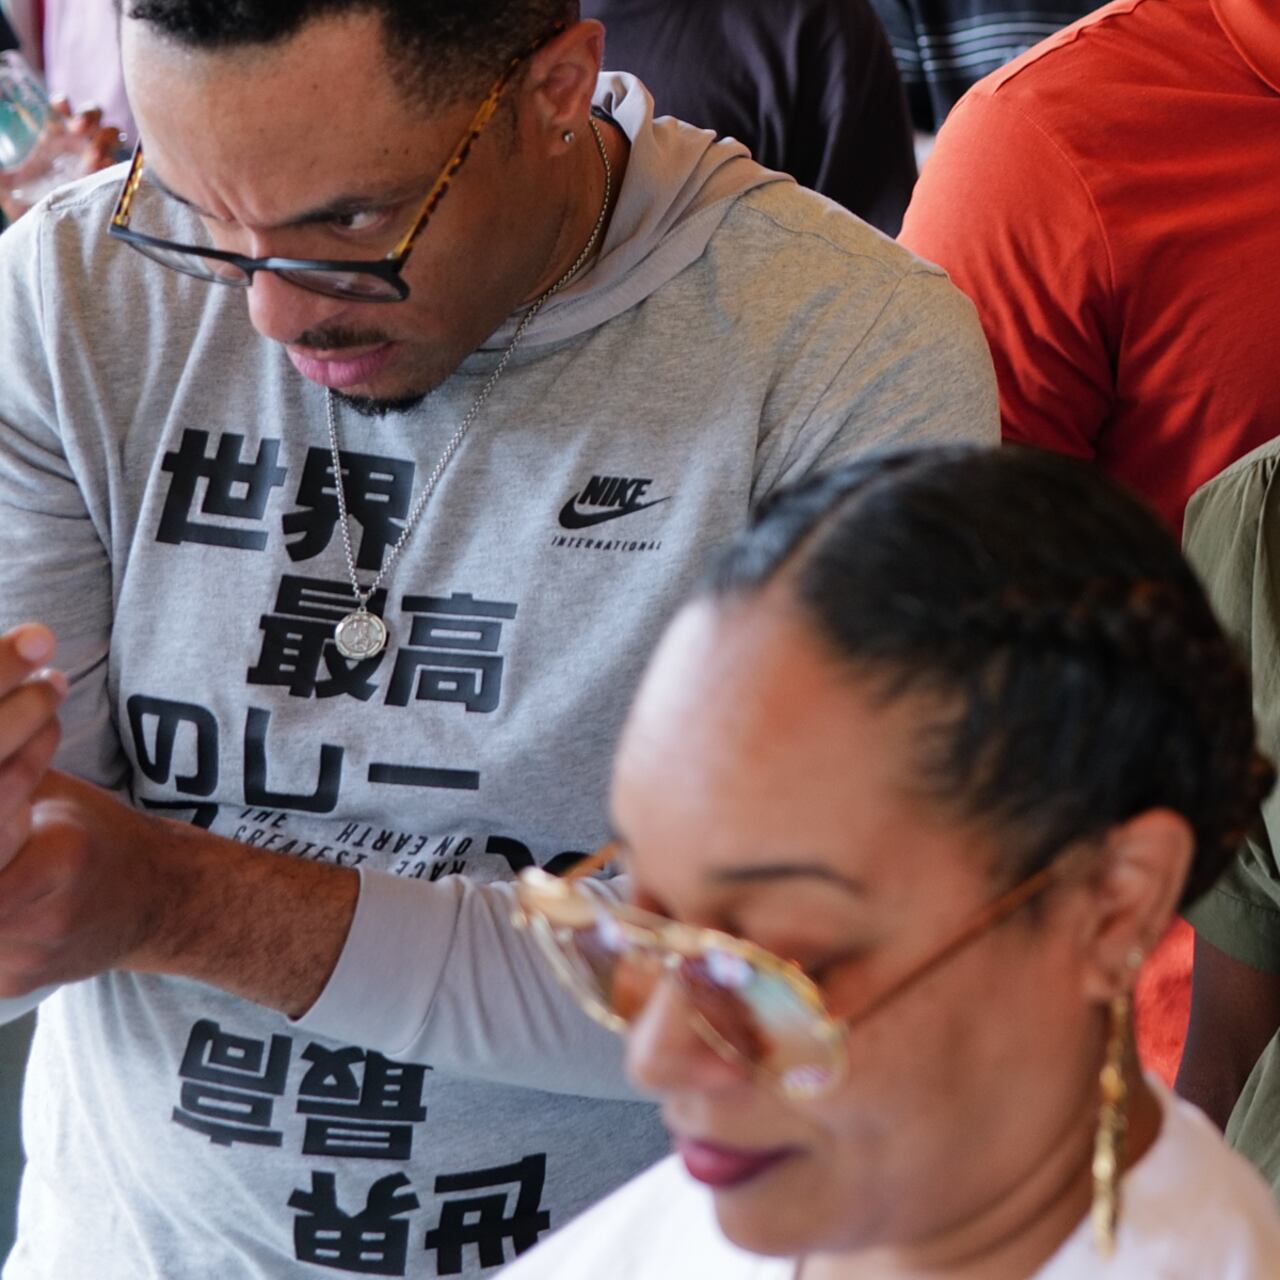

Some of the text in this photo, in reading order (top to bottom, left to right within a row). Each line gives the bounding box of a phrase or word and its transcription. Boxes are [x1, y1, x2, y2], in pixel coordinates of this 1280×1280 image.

[155, 429, 416, 572] 世界
[577, 475, 654, 507] NIKE
[551, 535, 663, 552] INTERNATIONAL
[246, 574, 518, 714] 最高
[335, 822, 428, 857] EARTH
